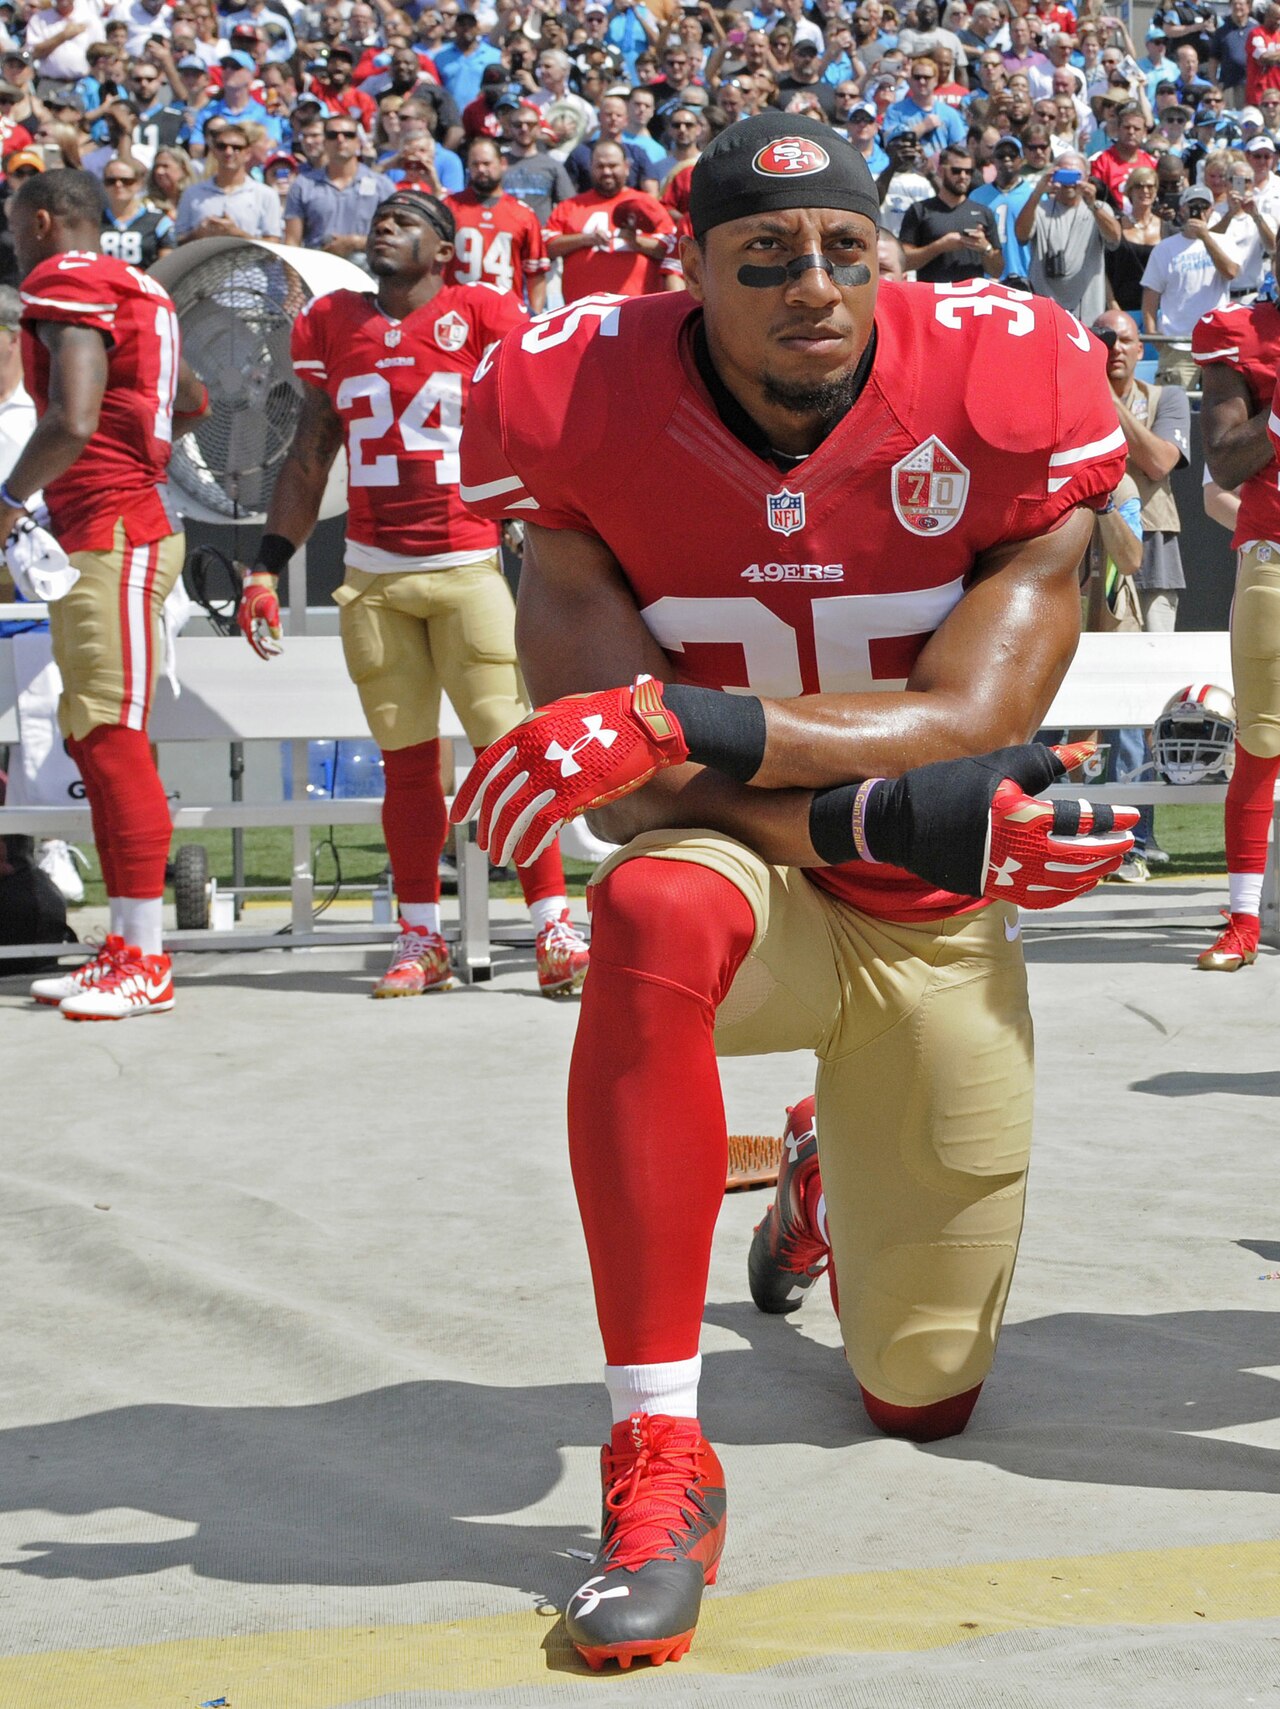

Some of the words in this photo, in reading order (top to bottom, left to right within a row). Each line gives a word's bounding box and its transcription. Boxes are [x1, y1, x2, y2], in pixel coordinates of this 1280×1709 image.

[100, 231, 142, 264] 88
[453, 226, 514, 291] 94
[336, 371, 463, 487] 24
[907, 475, 954, 505] 70
[773, 510, 800, 528] NFL
[740, 563, 844, 583] 49ERS
